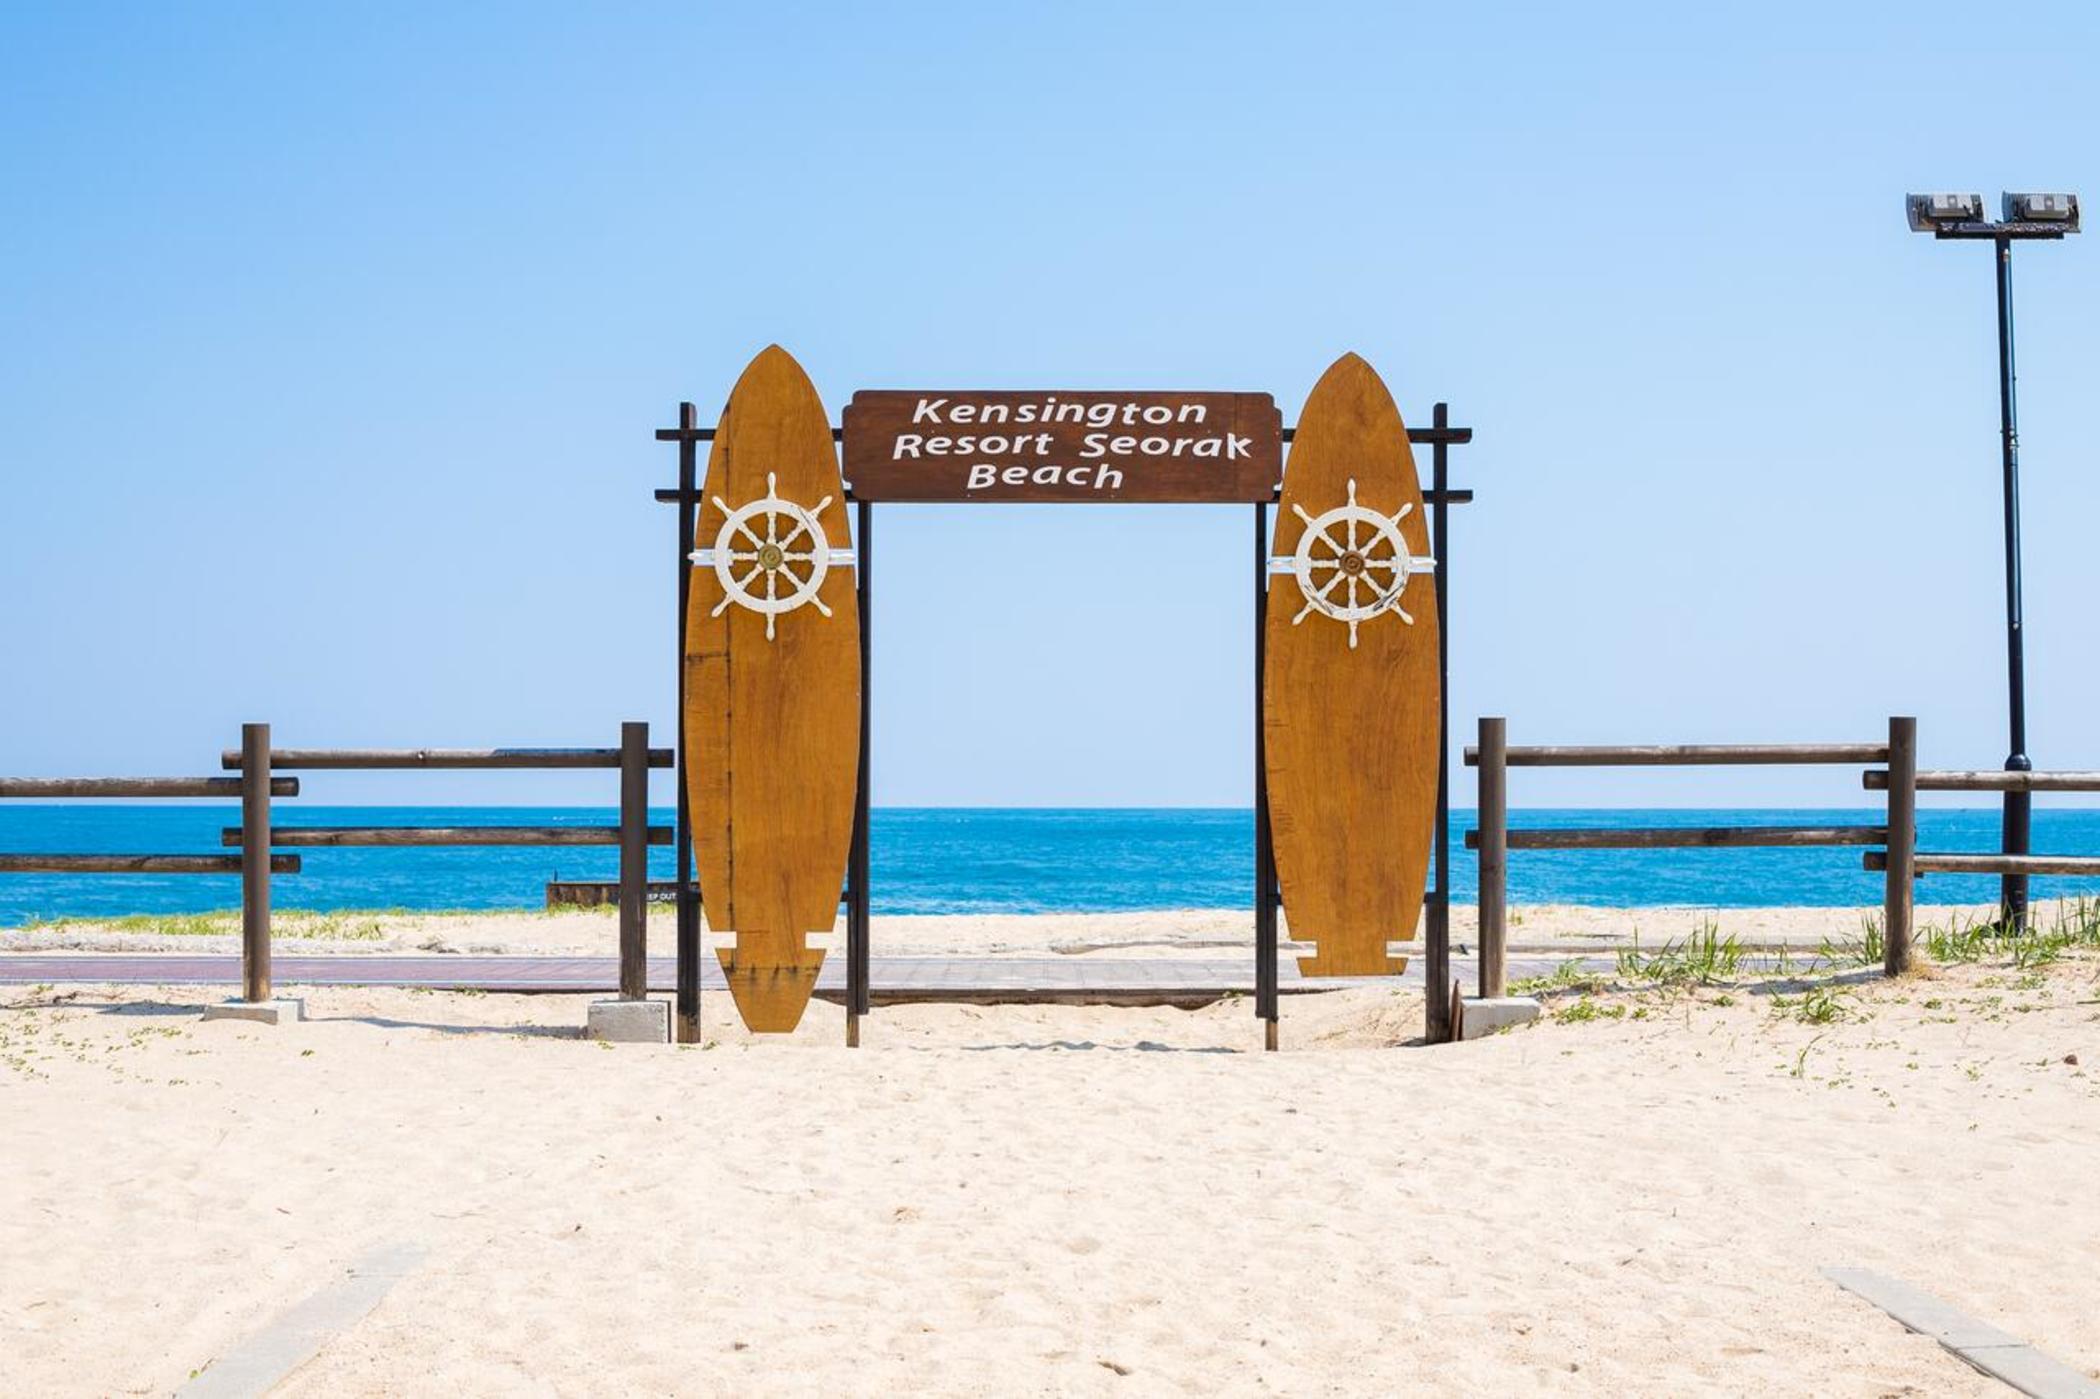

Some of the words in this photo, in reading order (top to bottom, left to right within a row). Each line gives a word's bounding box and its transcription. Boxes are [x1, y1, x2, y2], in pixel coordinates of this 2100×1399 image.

[912, 397, 1207, 428] Kensington
[892, 433, 1053, 460] Resort
[1079, 433, 1252, 460] Seorak
[966, 464, 1123, 490] Beach
[659, 892, 677, 901] OUT
